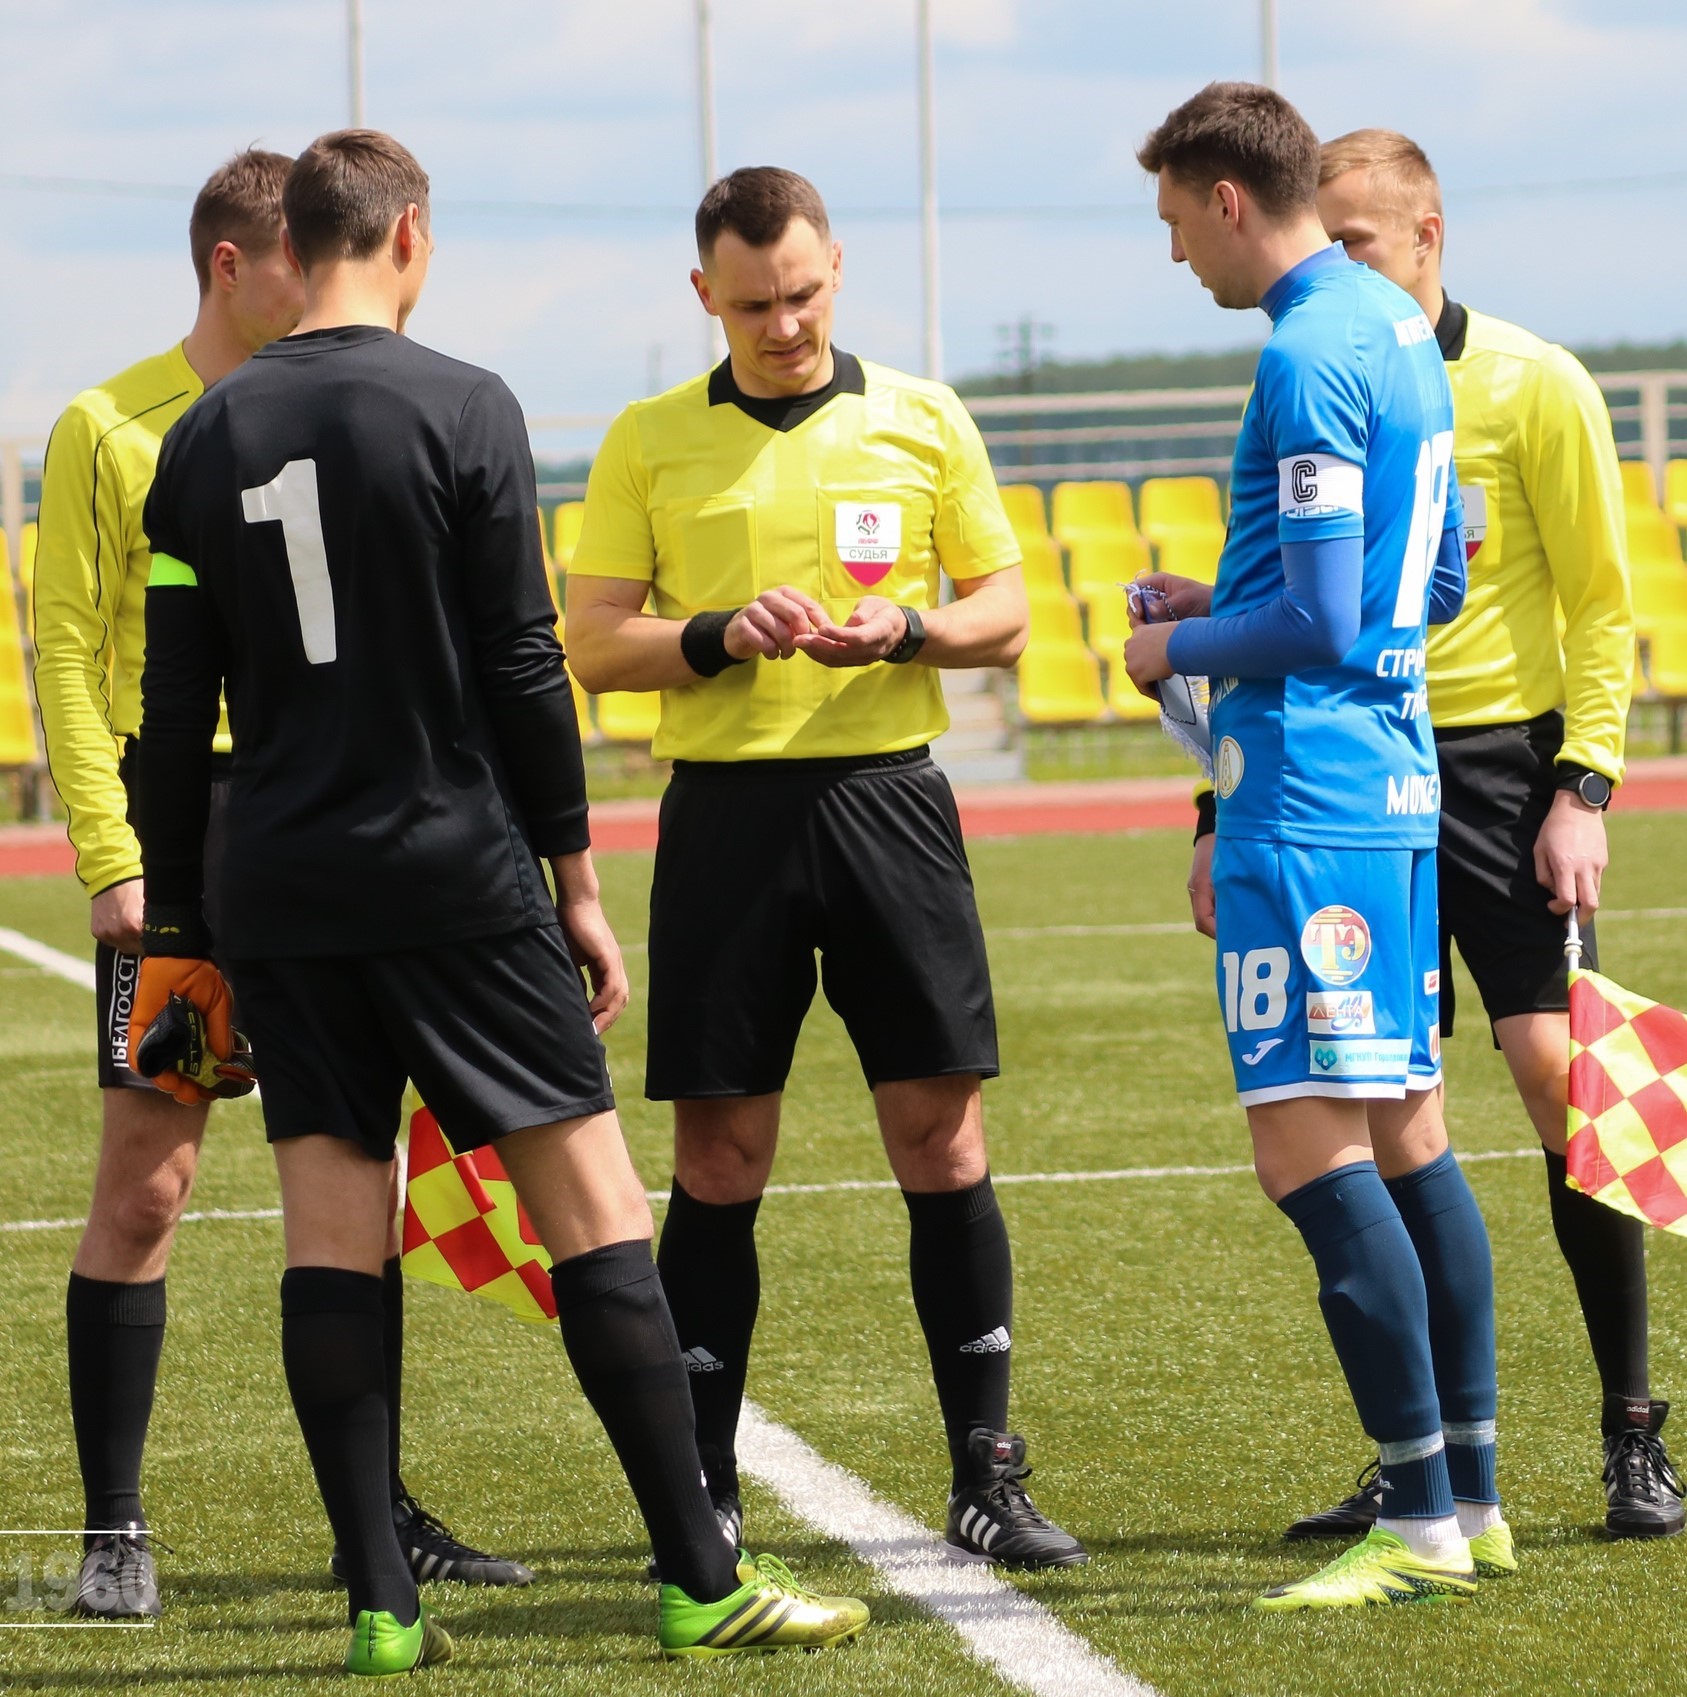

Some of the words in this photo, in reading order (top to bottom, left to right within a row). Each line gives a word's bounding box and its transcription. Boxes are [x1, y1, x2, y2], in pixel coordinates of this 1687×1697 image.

[241, 458, 337, 664] 1
[849, 549, 888, 560] СУДЬЯ
[1386, 773, 1442, 815] МОЖЕ
[1223, 946, 1291, 1033] 18
